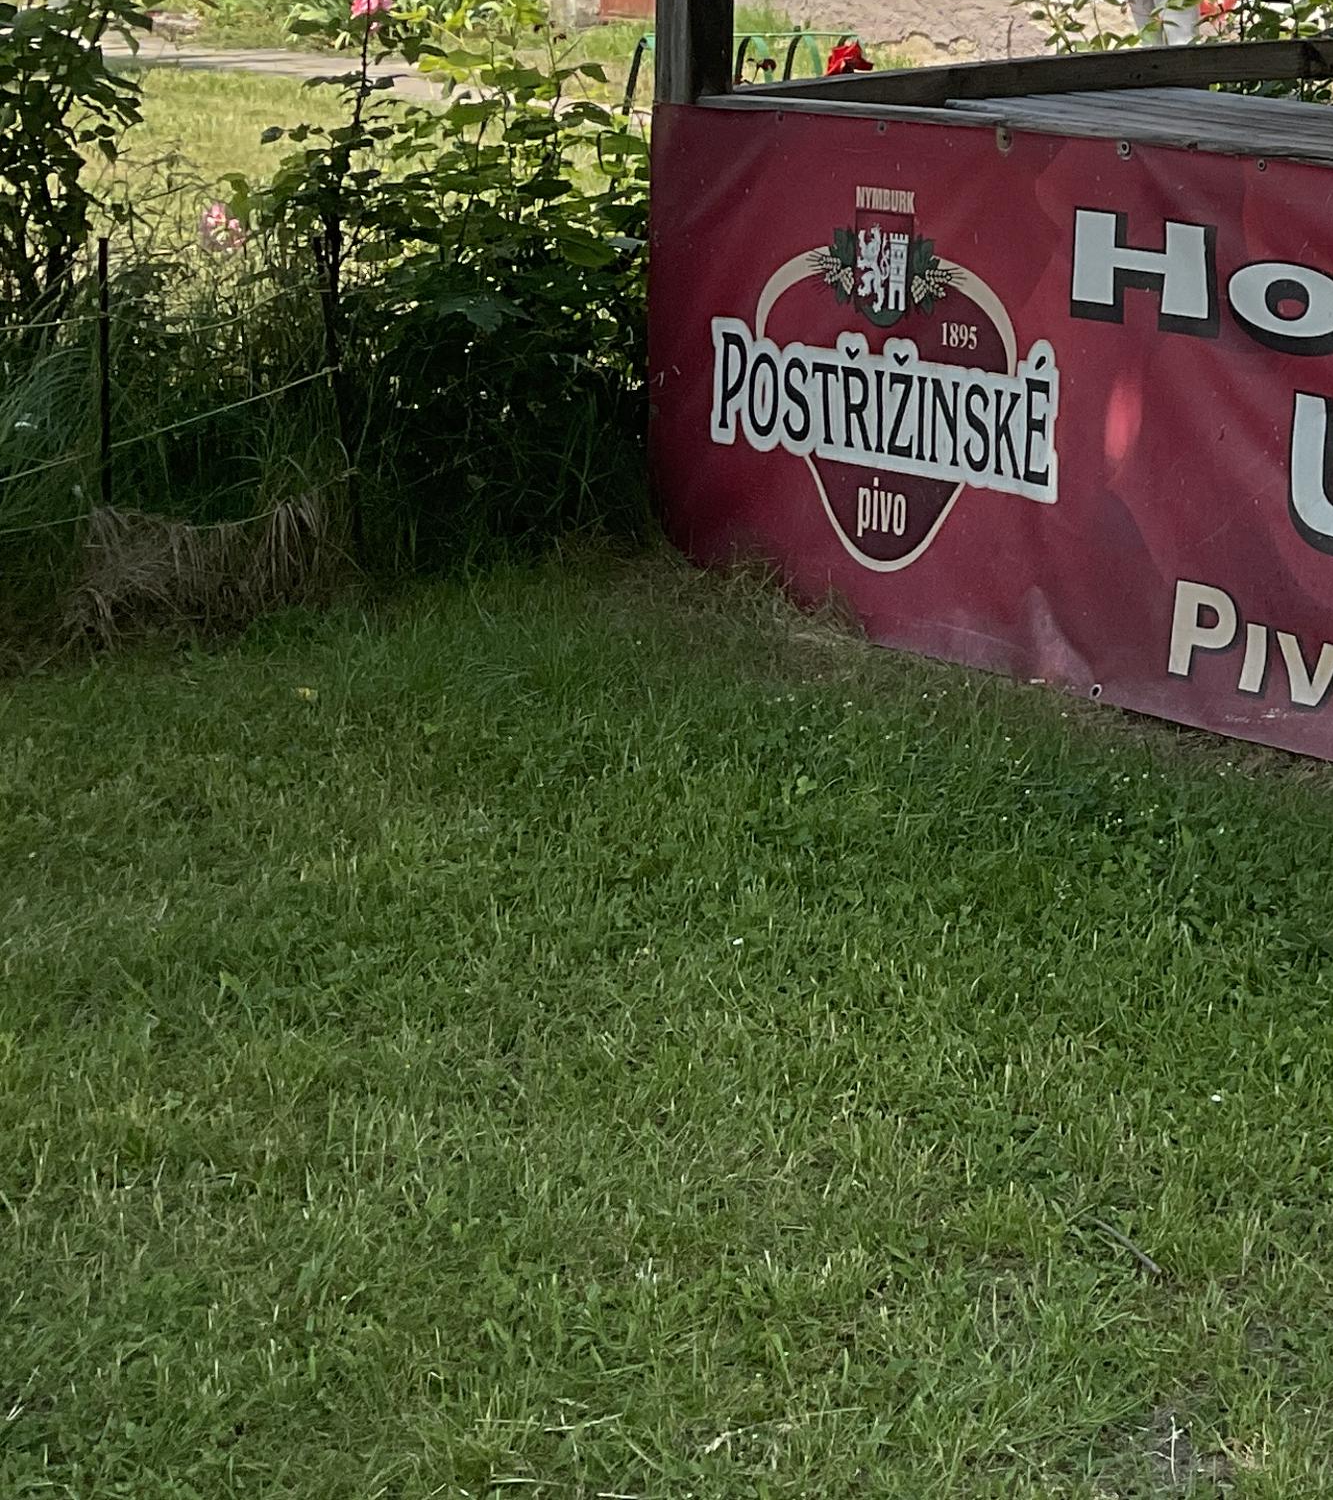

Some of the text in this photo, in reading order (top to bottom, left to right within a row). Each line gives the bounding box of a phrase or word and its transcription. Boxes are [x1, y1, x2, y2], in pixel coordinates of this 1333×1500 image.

[855, 185, 916, 215] NYMBURK
[940, 321, 979, 351] 1895
[716, 331, 1053, 488] POSTŘIŽINSKÉ
[856, 476, 908, 538] pivo
